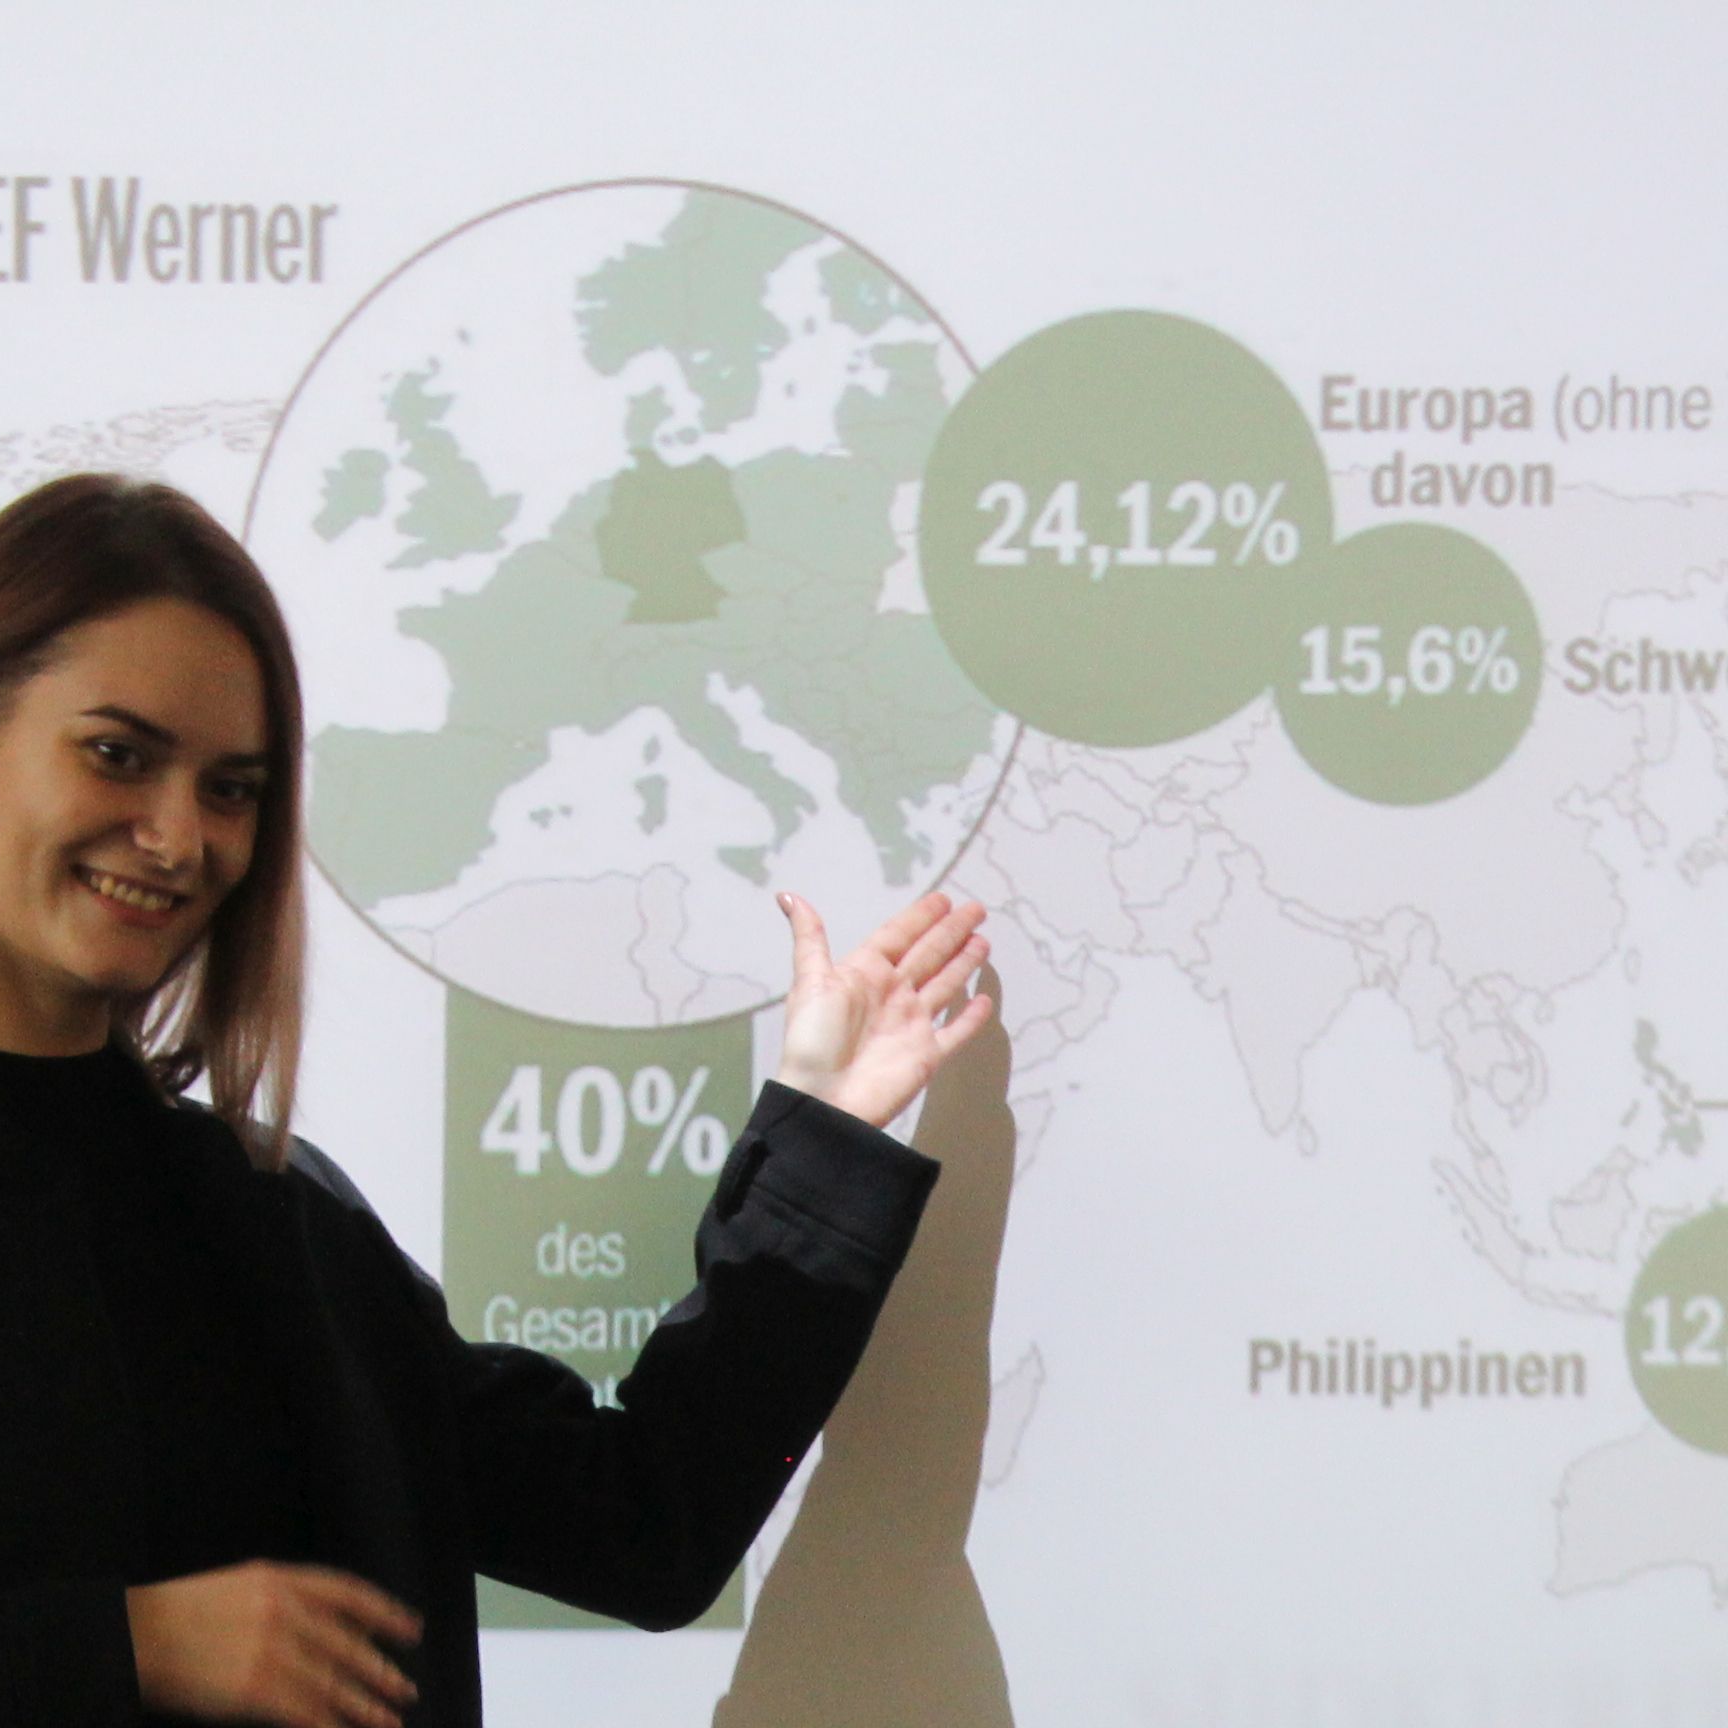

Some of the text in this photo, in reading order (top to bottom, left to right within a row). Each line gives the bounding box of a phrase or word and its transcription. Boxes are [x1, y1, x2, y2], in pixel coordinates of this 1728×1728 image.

[70, 175, 339, 284] Werner
[1318, 374, 1535, 441] Europa
[1552, 373, 1712, 440] (ohne
[1370, 452, 1555, 508] davon
[974, 480, 1300, 580] 24,12%
[1299, 625, 1520, 707] 15,6%
[479, 1064, 727, 1177] 40%
[536, 1222, 626, 1277] des
[483, 1294, 672, 1352] Gesam
[1248, 1337, 1587, 1408] Philippinen
